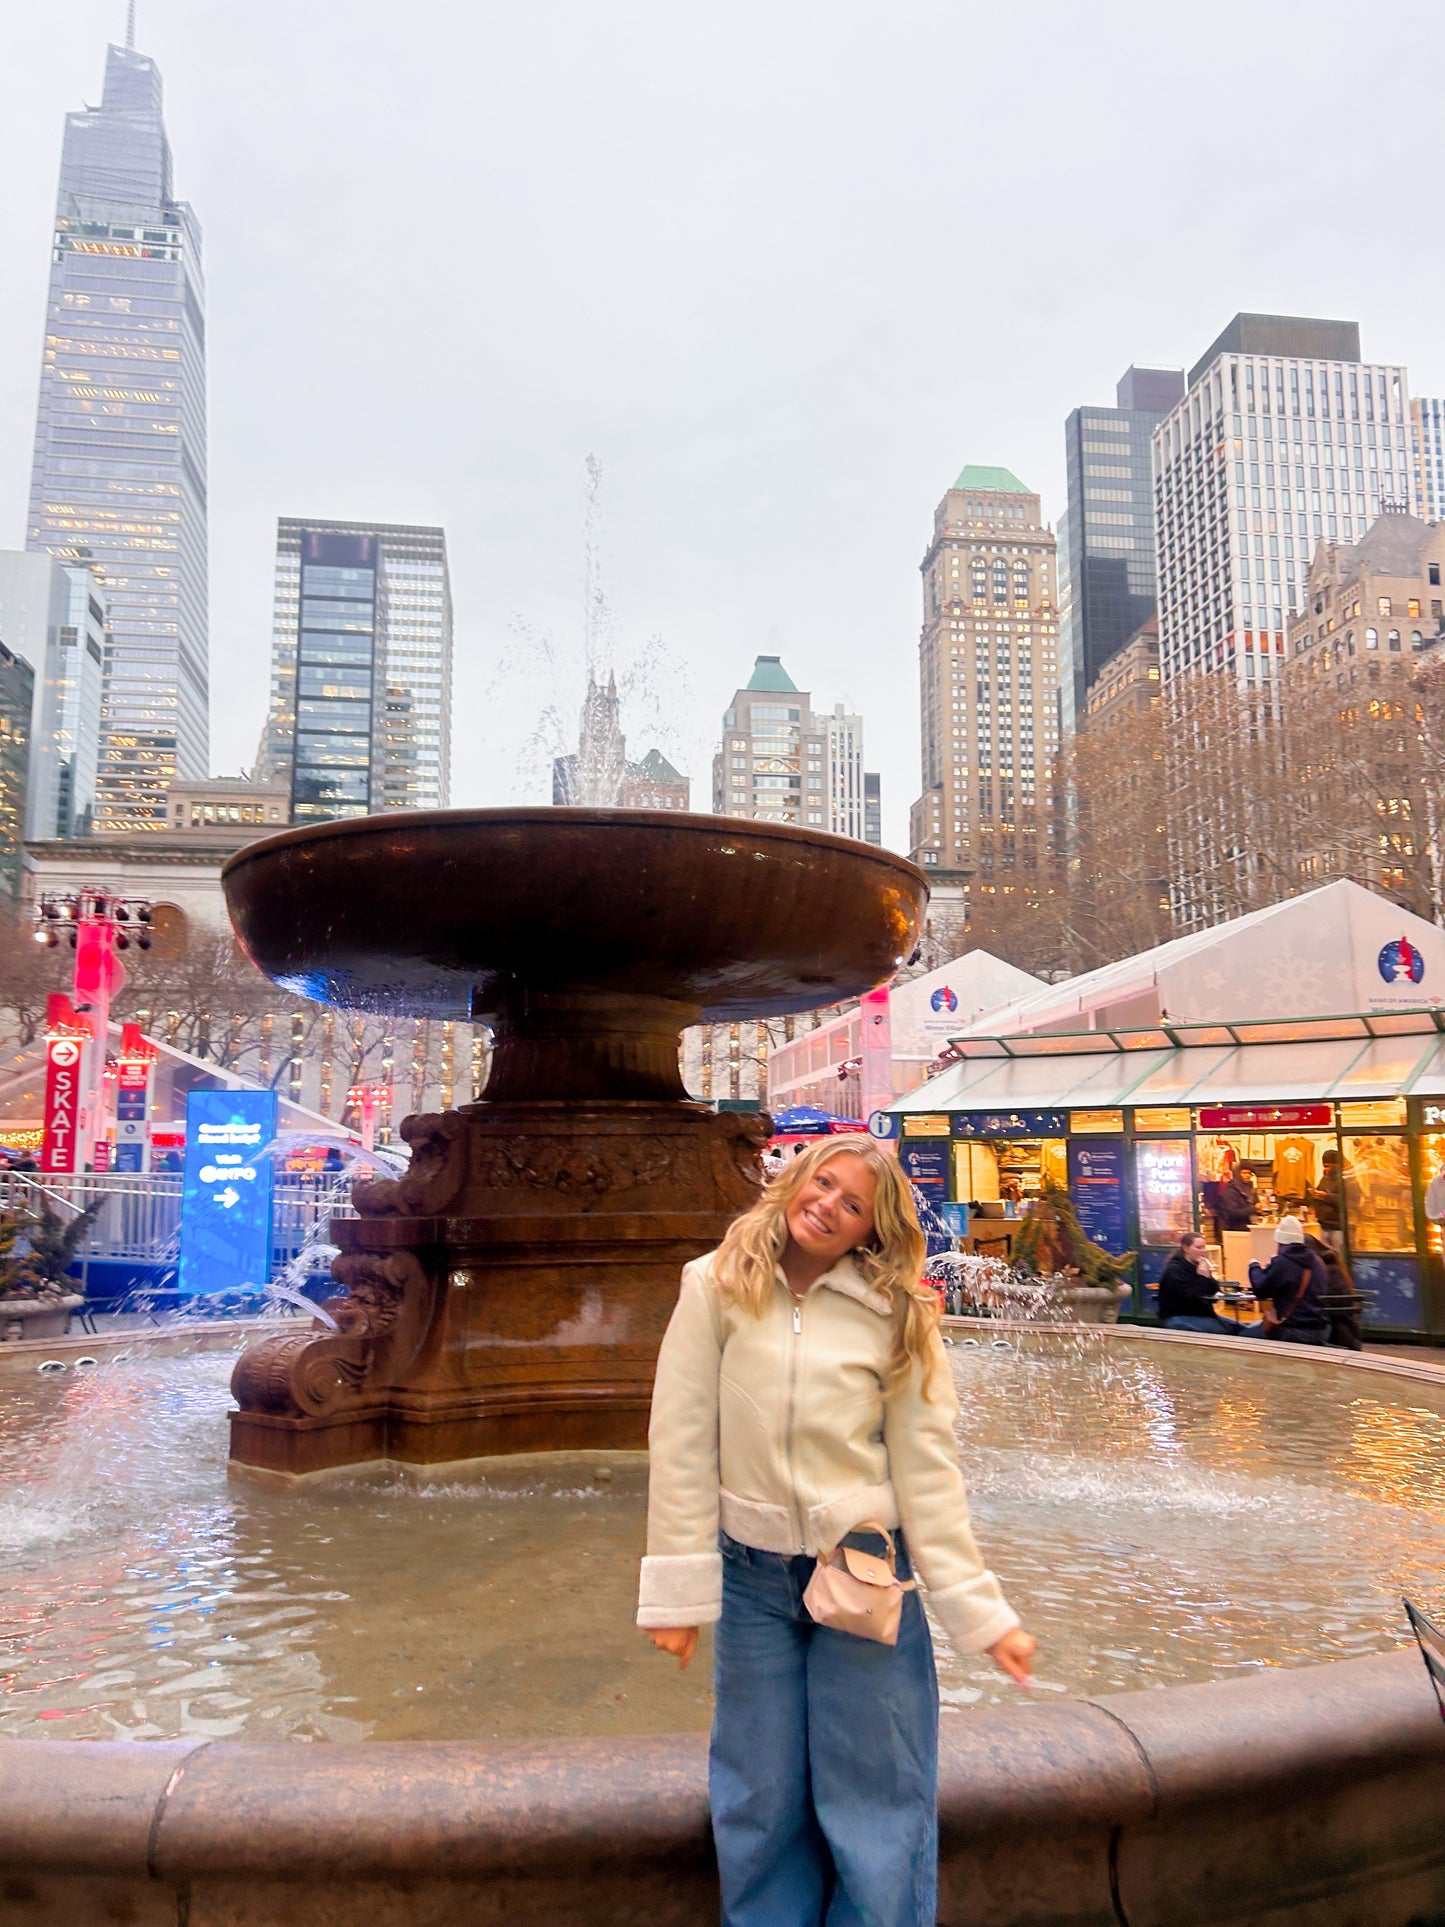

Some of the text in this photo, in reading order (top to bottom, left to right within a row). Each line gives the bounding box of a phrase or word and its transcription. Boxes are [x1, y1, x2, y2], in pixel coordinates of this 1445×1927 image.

[50, 1071, 73, 1168] SKATE
[1144, 1152, 1185, 1169] Bryant
[1151, 1167, 1179, 1180] Park
[1148, 1180, 1183, 1196] Shop
